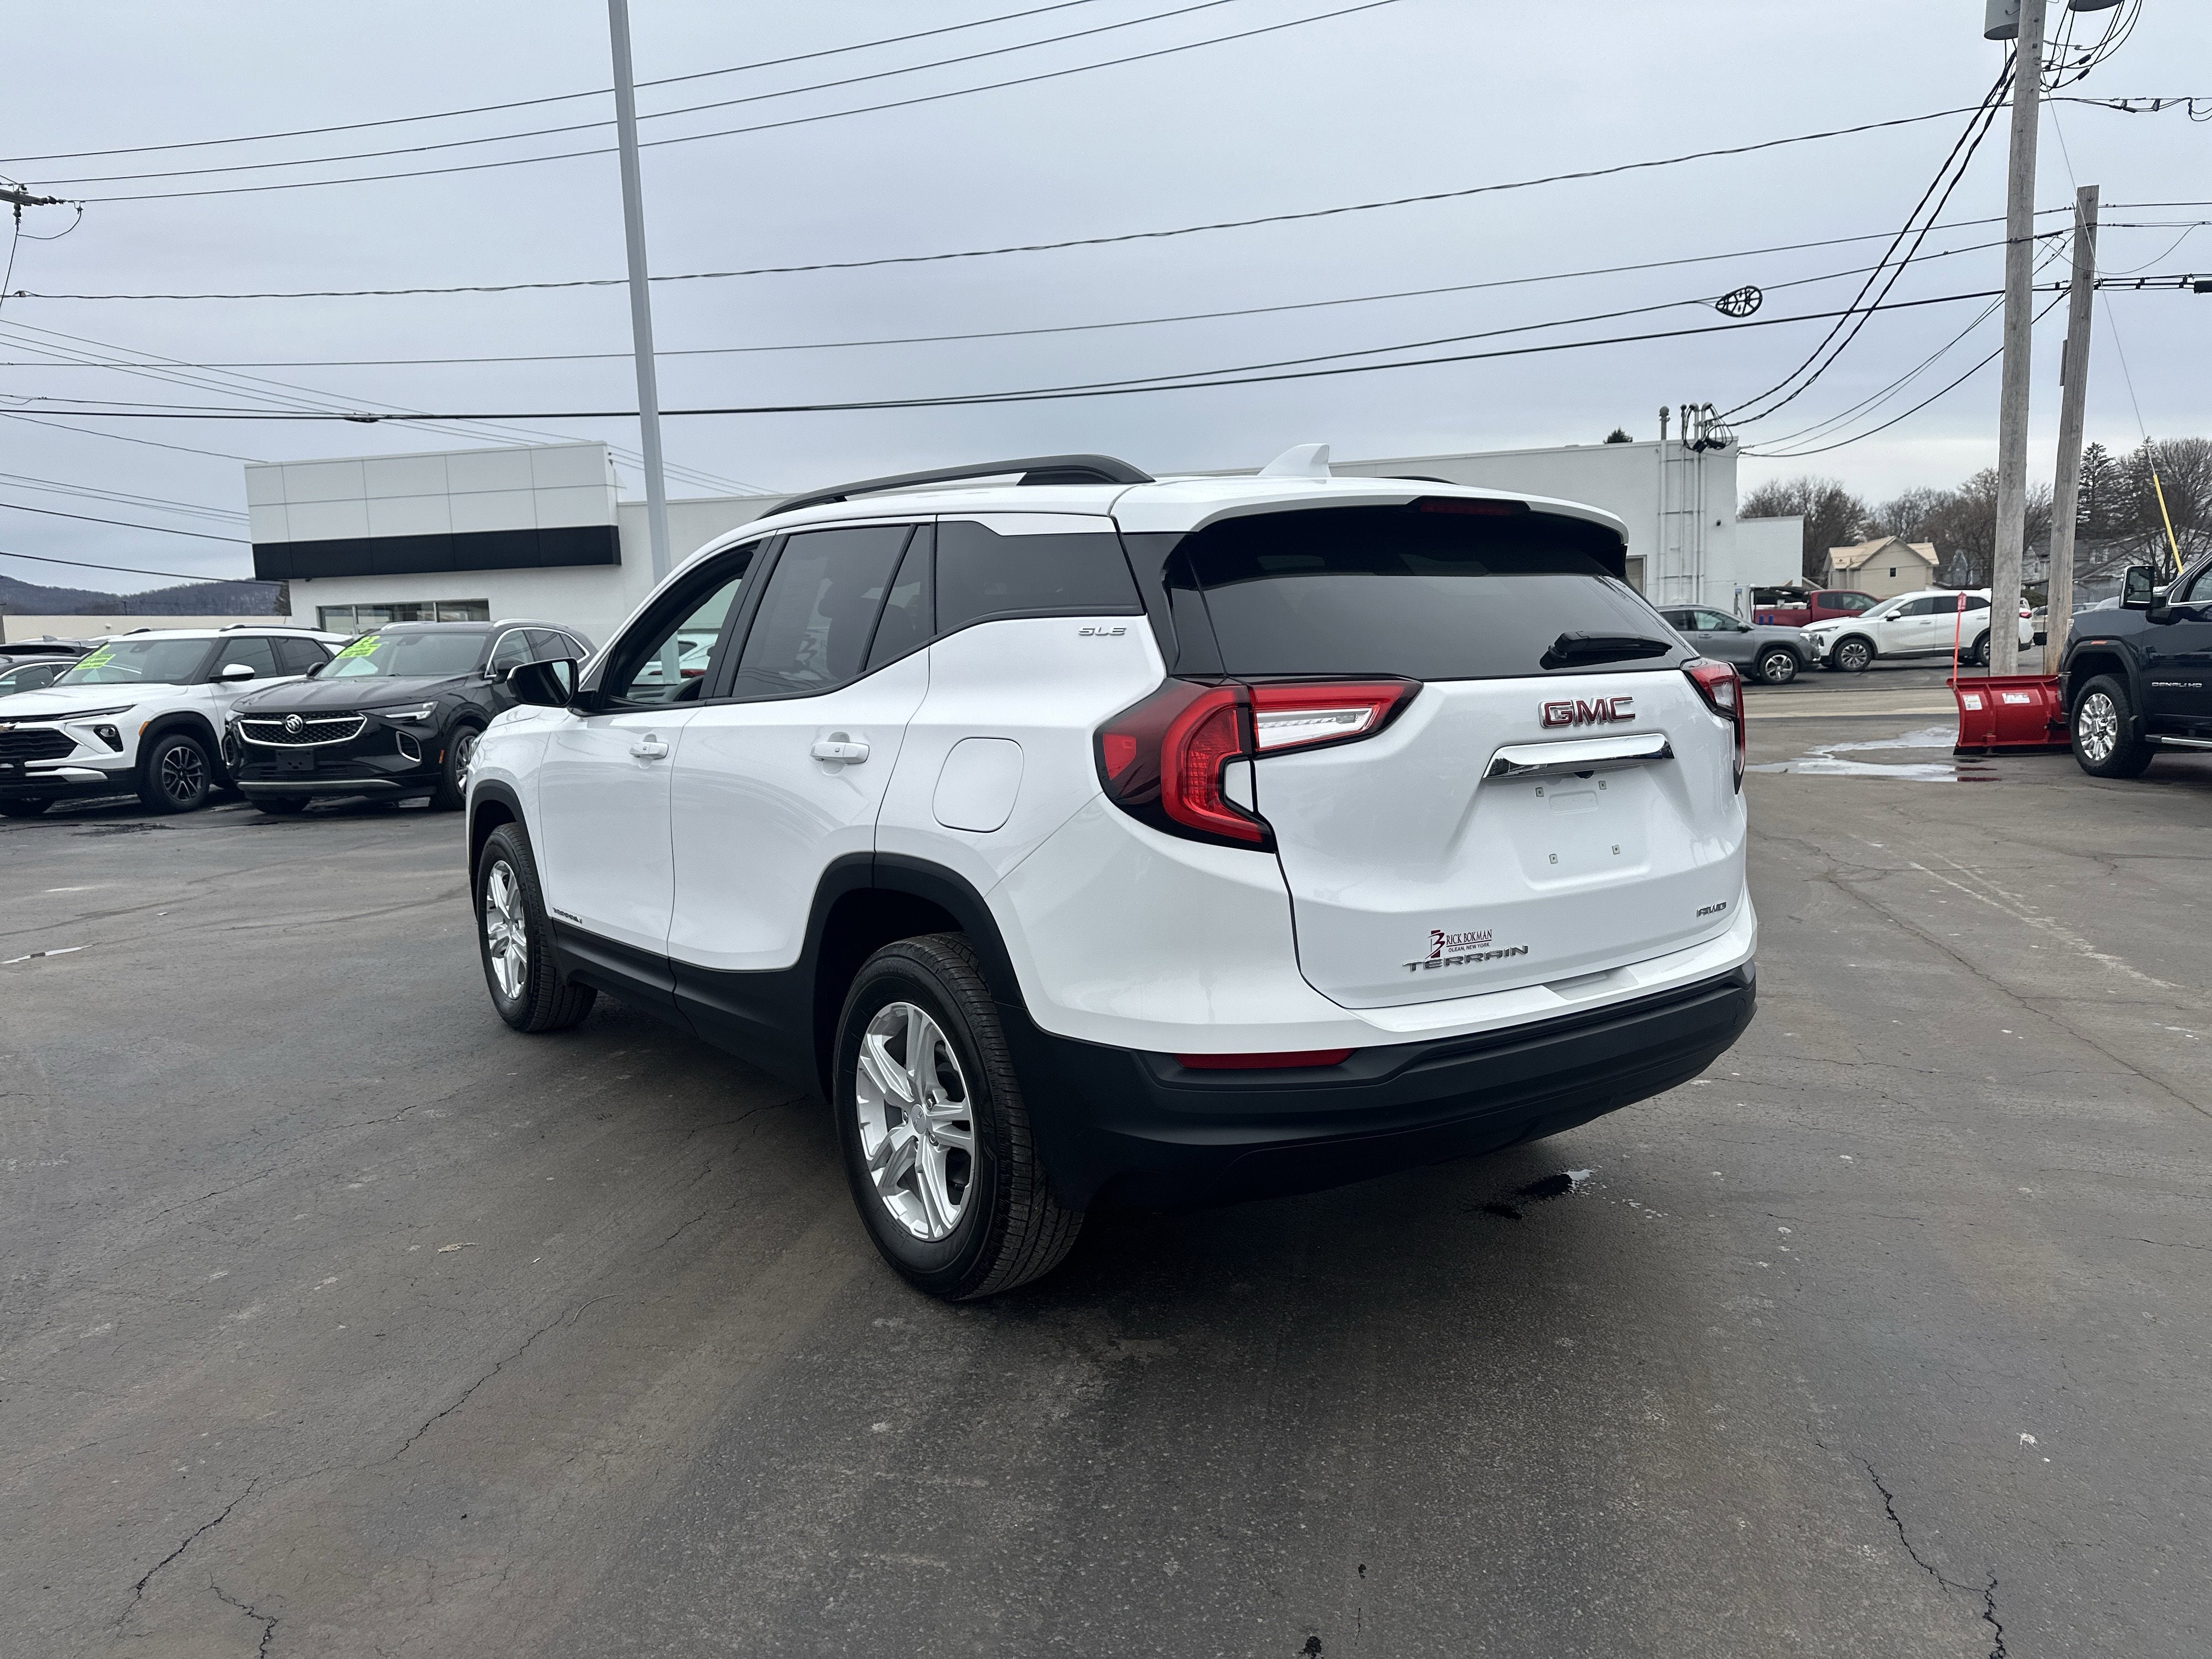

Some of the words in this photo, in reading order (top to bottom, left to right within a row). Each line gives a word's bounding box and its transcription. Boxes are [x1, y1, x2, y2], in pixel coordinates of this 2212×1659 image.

[1078, 627, 1127, 636] SLE
[1538, 695, 1636, 729] GMC
[1696, 901, 1727, 917] AWD
[1446, 933, 1462, 945] RICK
[1463, 929, 1492, 942] BOKMAN
[1402, 944, 1528, 972] TERRAIN
